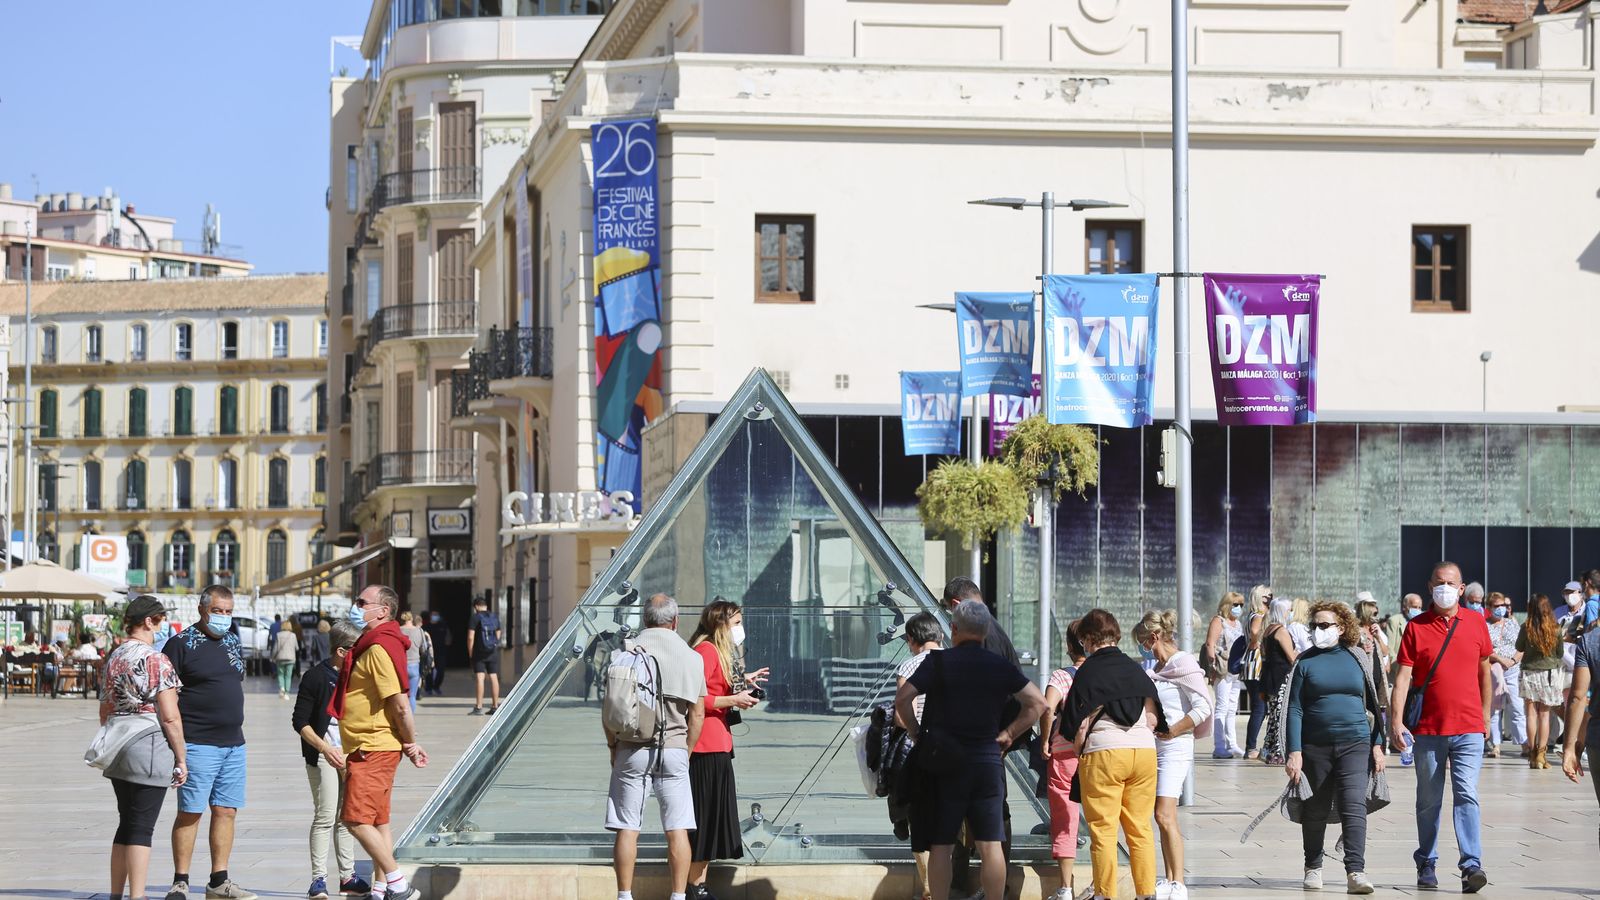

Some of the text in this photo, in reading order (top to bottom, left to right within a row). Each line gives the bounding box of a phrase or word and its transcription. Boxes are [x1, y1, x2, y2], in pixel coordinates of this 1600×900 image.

[596, 122, 655, 178] 26
[598, 186, 655, 204] FESTIVAL
[598, 203, 655, 222] DE CINE
[598, 220, 656, 239] FRANCÉS
[617, 239, 656, 249] MÁLAGA
[963, 319, 1029, 355] DZM
[1053, 316, 1149, 367] DZM
[1215, 313, 1310, 365] DZM
[1237, 369, 1263, 379] MÁLAGA
[1263, 371, 1279, 379] 2020
[906, 393, 958, 421] DZM
[1225, 405, 1289, 413] teatrocervantes.es
[502, 490, 634, 524] CINES
